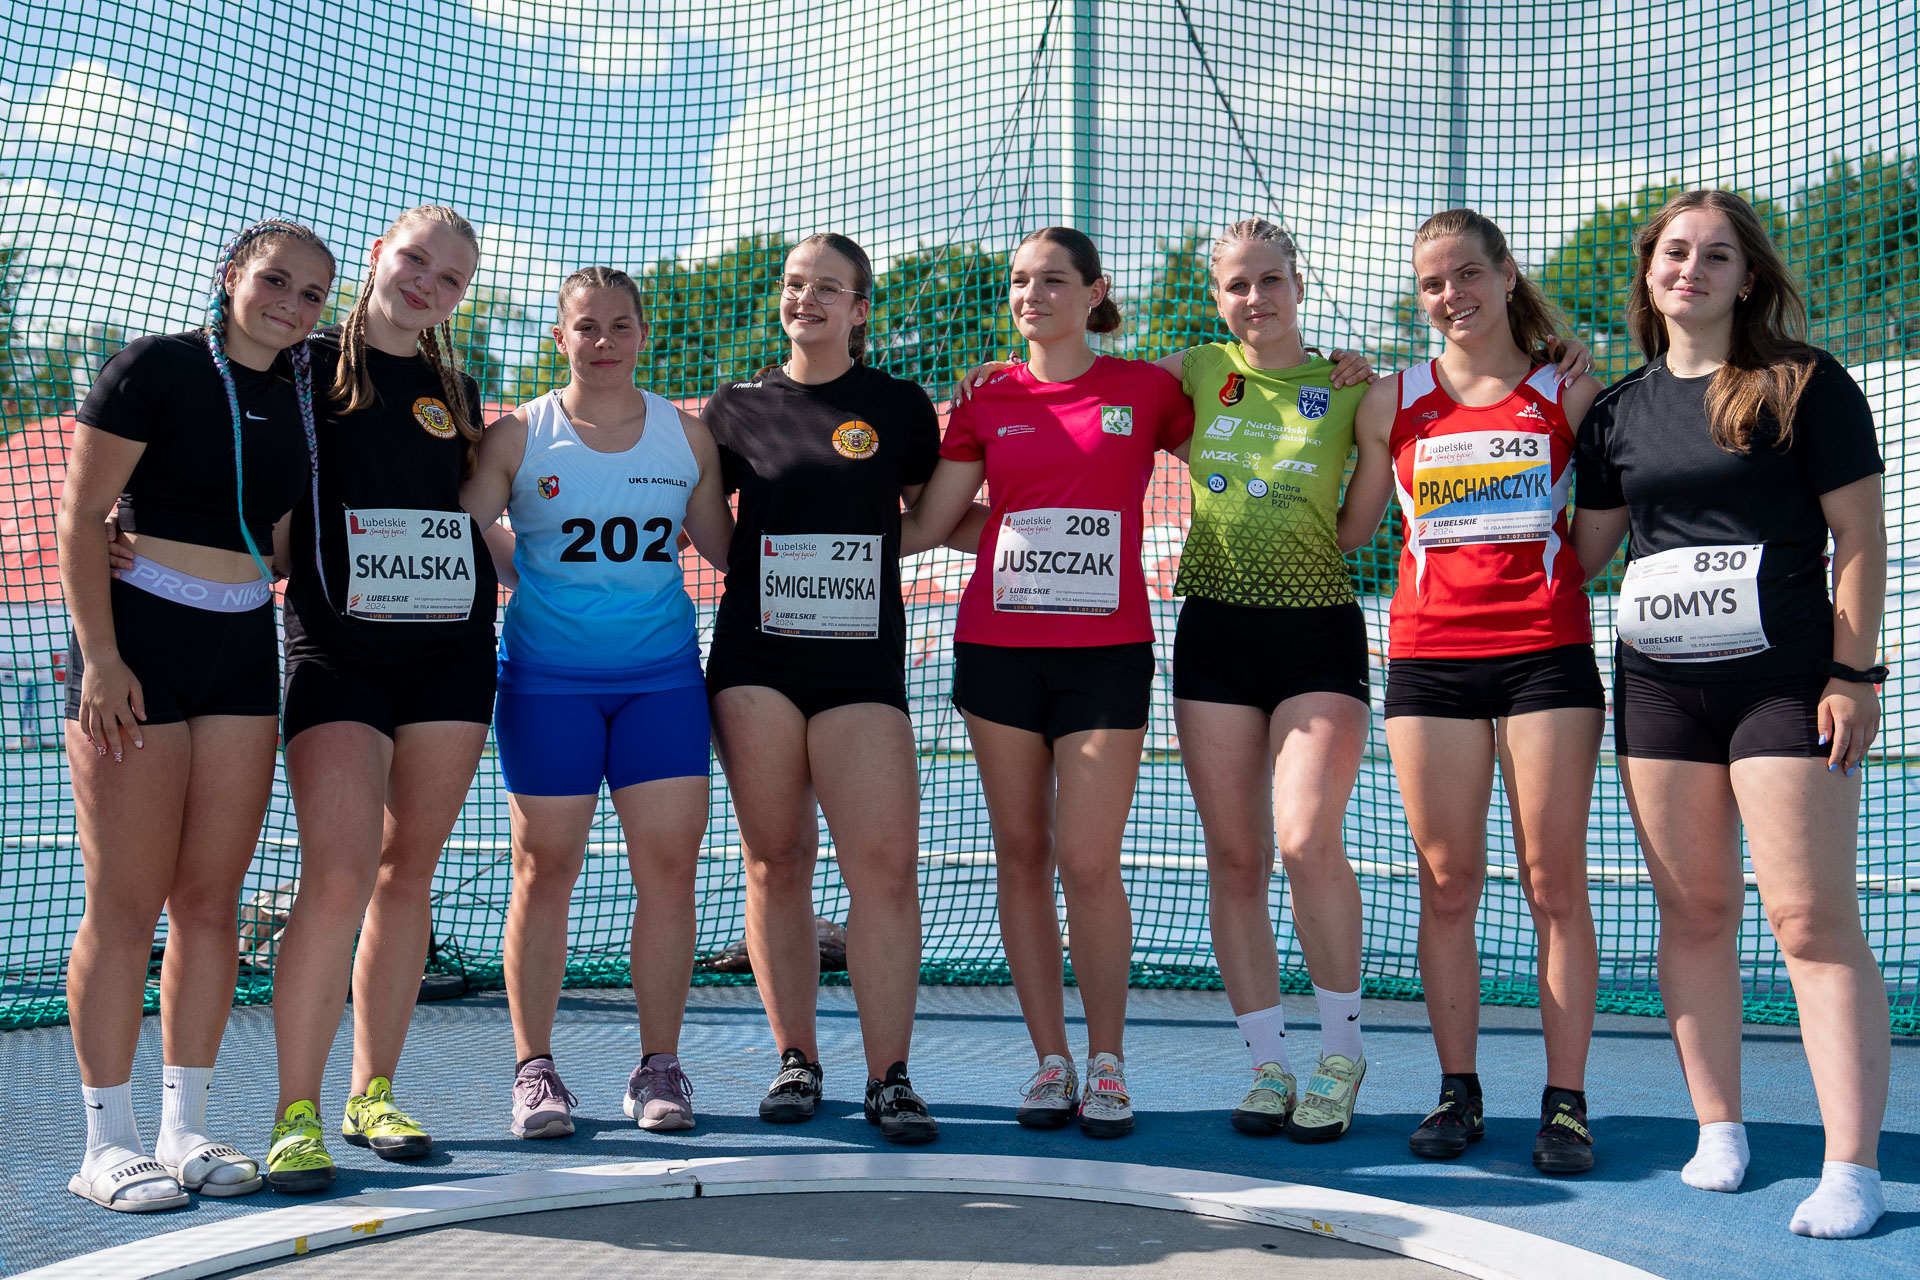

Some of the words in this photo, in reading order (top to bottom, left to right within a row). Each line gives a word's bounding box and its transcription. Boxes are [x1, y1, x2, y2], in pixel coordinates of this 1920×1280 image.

[1302, 390, 1327, 401] STAL
[1245, 420, 1308, 435] Nadsański
[1244, 430, 1265, 438] Bank
[1267, 432, 1323, 446] Spółdzielczy
[1429, 441, 1473, 454] lubelskie
[1489, 437, 1539, 458] 343
[1200, 450, 1239, 462] MZK
[1272, 459, 1318, 472] ATS
[651, 477, 688, 488] ACHILLES
[1211, 478, 1223, 488] PZU
[1273, 482, 1300, 493] Dobra
[1419, 473, 1547, 506] PRACHARCZYK
[1272, 500, 1290, 509] PZU
[362, 517, 407, 528] lubelskie
[1013, 515, 1052, 526] lubelskie
[1066, 515, 1110, 537] 208
[1433, 517, 1478, 528] LUBELSKIE
[421, 517, 462, 540] 268
[1433, 527, 1454, 536] 2024
[560, 516, 673, 563] 202
[775, 542, 817, 551] lubelskie
[831, 541, 873, 562] 271
[355, 554, 471, 581] SKALSKA
[998, 550, 1114, 576] JUSZCZAK
[1693, 550, 1747, 572] 830
[129, 564, 209, 600] PRO
[221, 582, 270, 606] NIKE
[765, 570, 876, 600] ŚMIGLEWSKA
[1009, 587, 1051, 595] LUBELSKIE
[366, 594, 410, 602] LUBELSKIE
[1009, 594, 1028, 602] 2024
[1634, 588, 1737, 621] TOMYS
[365, 602, 387, 610] 2024
[775, 612, 817, 620] LUBELSKIE
[775, 618, 794, 626] 2024
[1638, 635, 1684, 645] LUBELSKIE
[774, 1070, 808, 1087] NIKE
[1098, 1078, 1127, 1095] NIKE
[1306, 1075, 1339, 1096] NIKE
[1551, 1112, 1589, 1137] NIKE
[111, 1161, 168, 1183] PUMA
